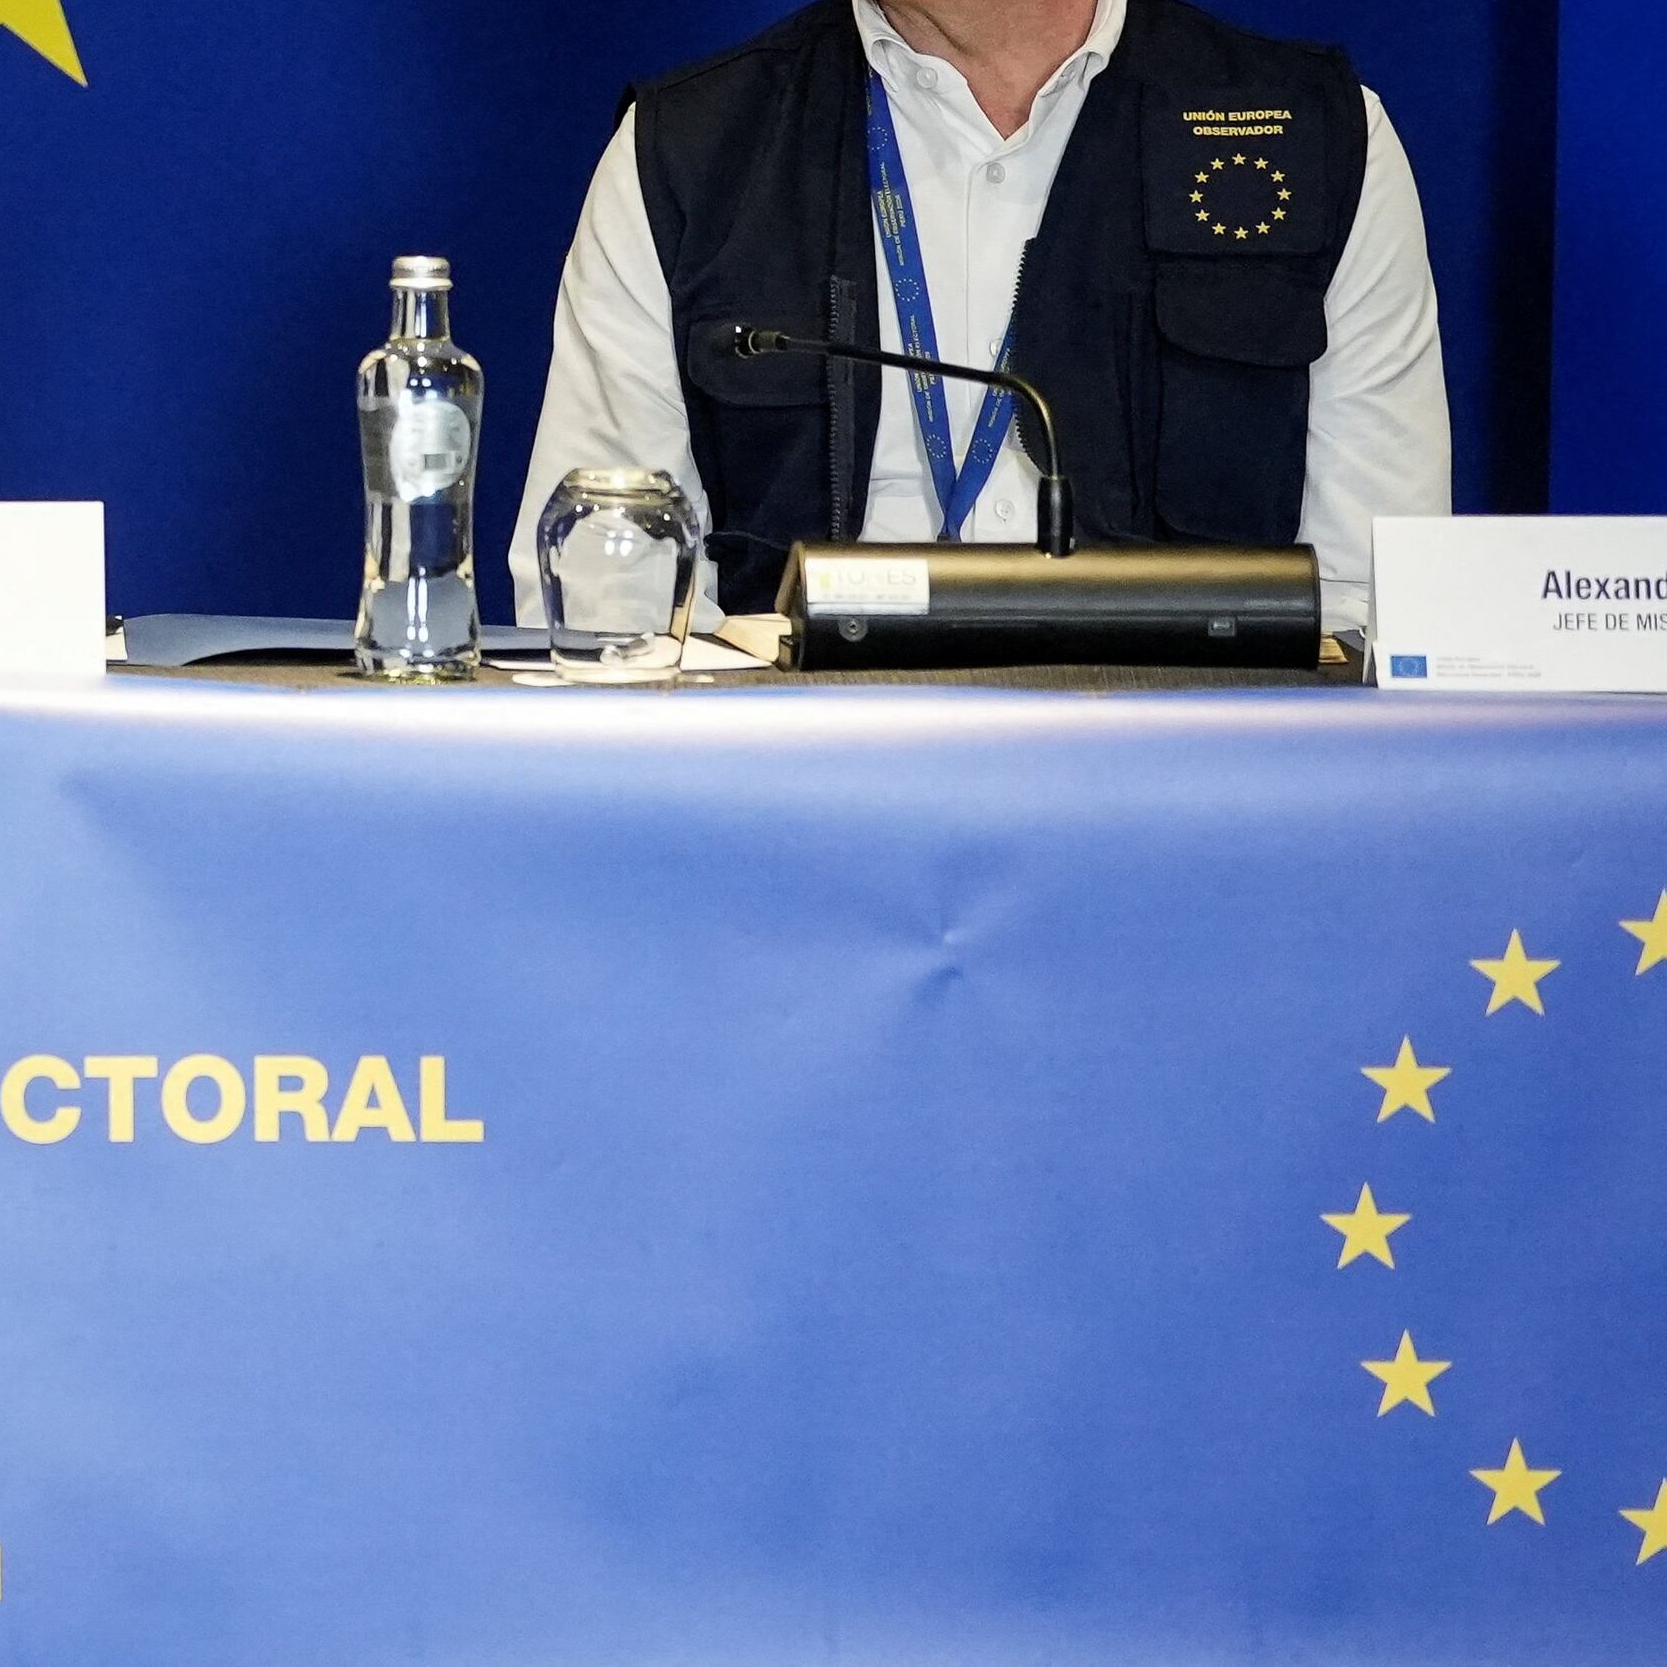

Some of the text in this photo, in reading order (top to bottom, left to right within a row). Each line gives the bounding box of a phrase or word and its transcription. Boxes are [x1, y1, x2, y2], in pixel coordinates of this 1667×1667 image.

[1182, 109, 1293, 122] UNIÓN EUROPEA
[1193, 125, 1284, 137] OBSERVADOR
[1553, 612, 1597, 631] JEFE
[1604, 612, 1629, 631] DE
